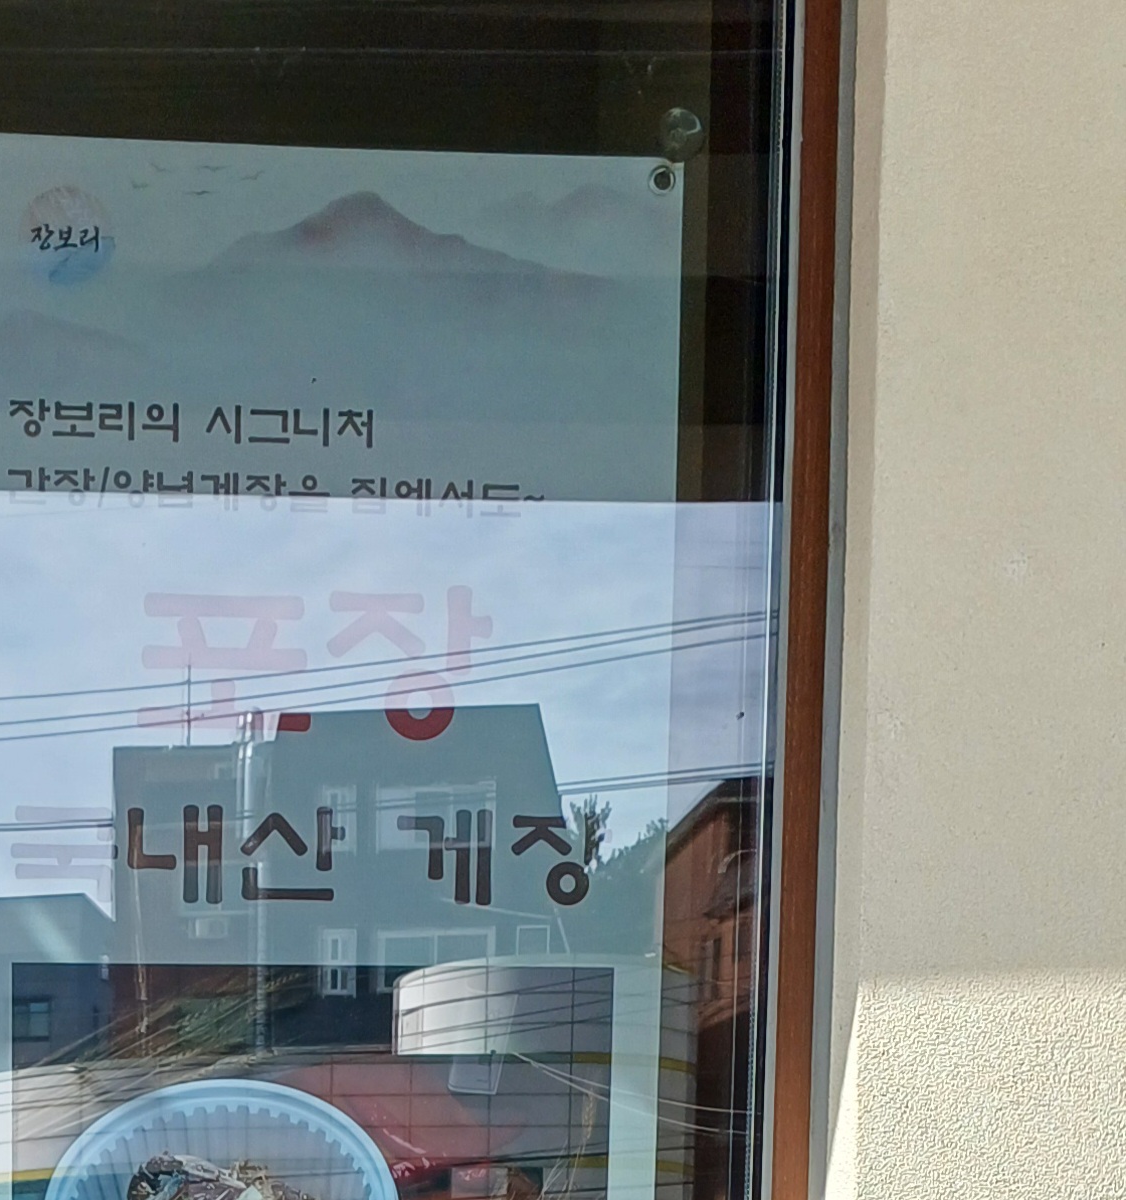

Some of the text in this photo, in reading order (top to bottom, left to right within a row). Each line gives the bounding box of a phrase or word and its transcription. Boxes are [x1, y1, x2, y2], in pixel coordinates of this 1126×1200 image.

[30, 224, 103, 252] 장보리
[8, 399, 375, 448] 장보리의 시그니처
[7, 466, 330, 512] 간장/양념게장을
[136, 584, 493, 741] 포장
[397, 808, 612, 906] 게장
